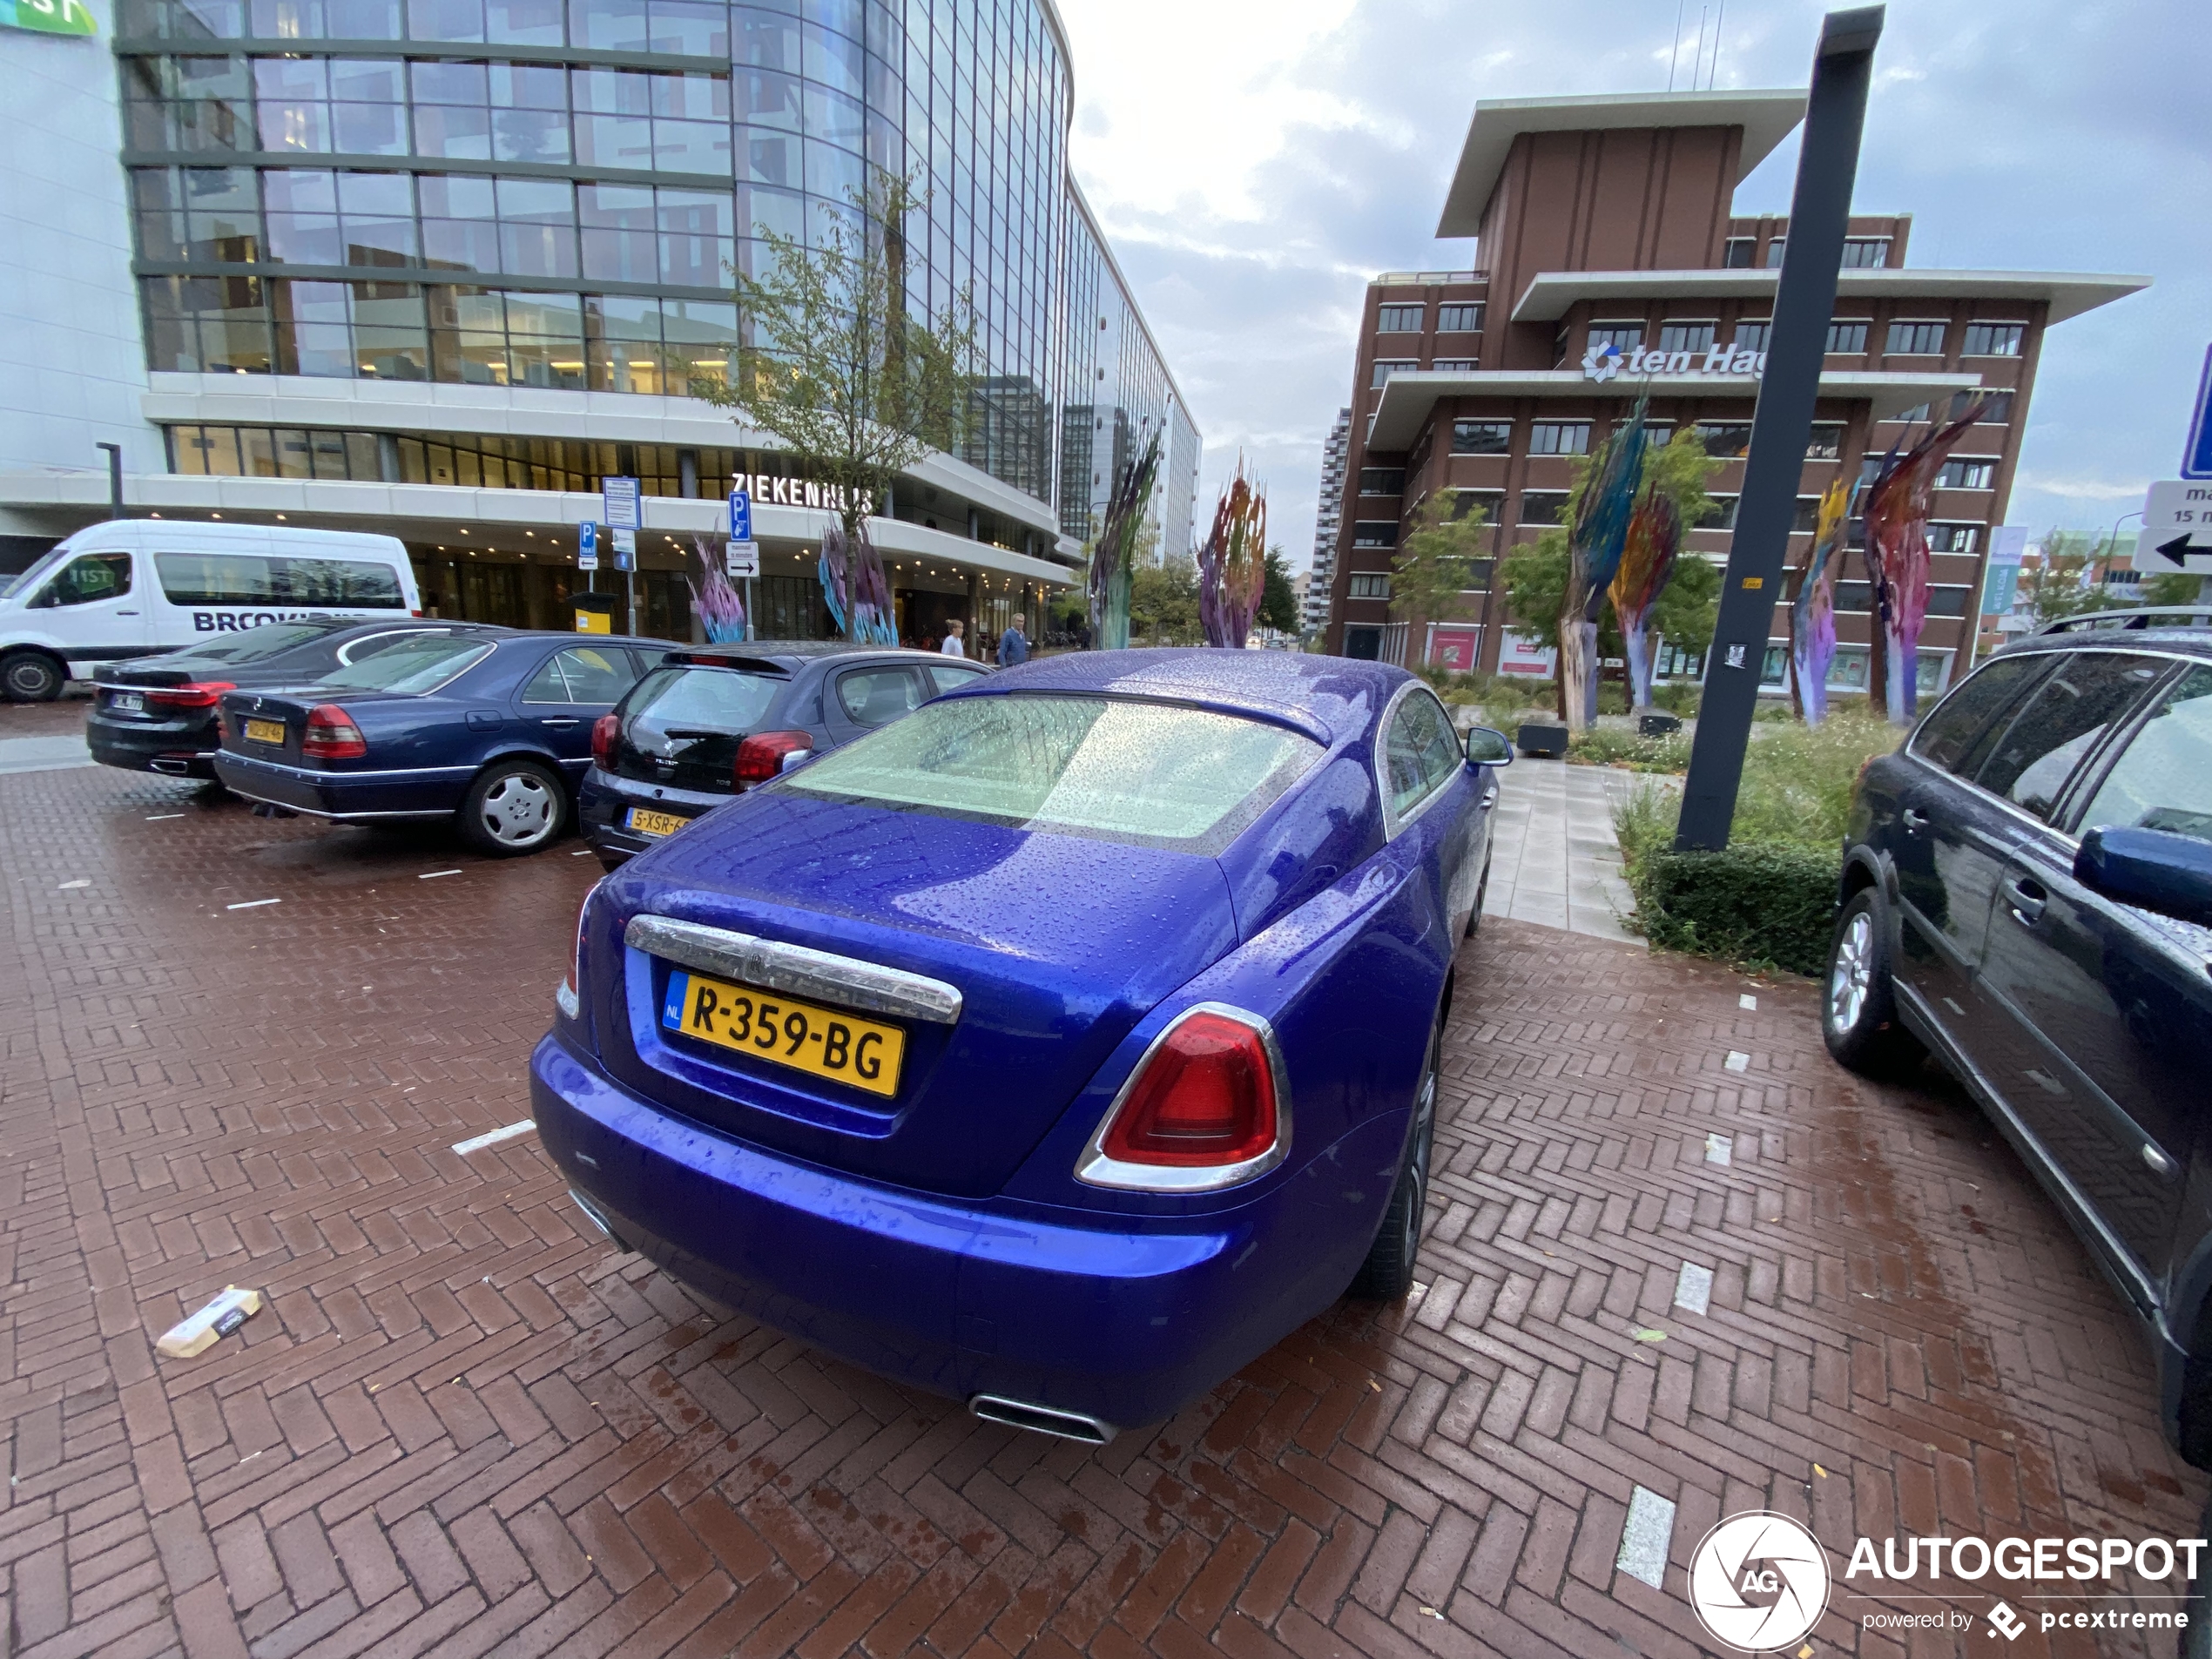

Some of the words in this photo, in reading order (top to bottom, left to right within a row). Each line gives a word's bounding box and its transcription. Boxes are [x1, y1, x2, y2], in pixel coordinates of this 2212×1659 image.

[1629, 344, 1691, 374] ten
[733, 497, 744, 520] P
[2174, 509, 2194, 523] 15
[583, 524, 592, 542] P
[635, 811, 691, 833] 5-XSR-6
[666, 1004, 680, 1021] NL
[692, 986, 883, 1080] R-359-BG
